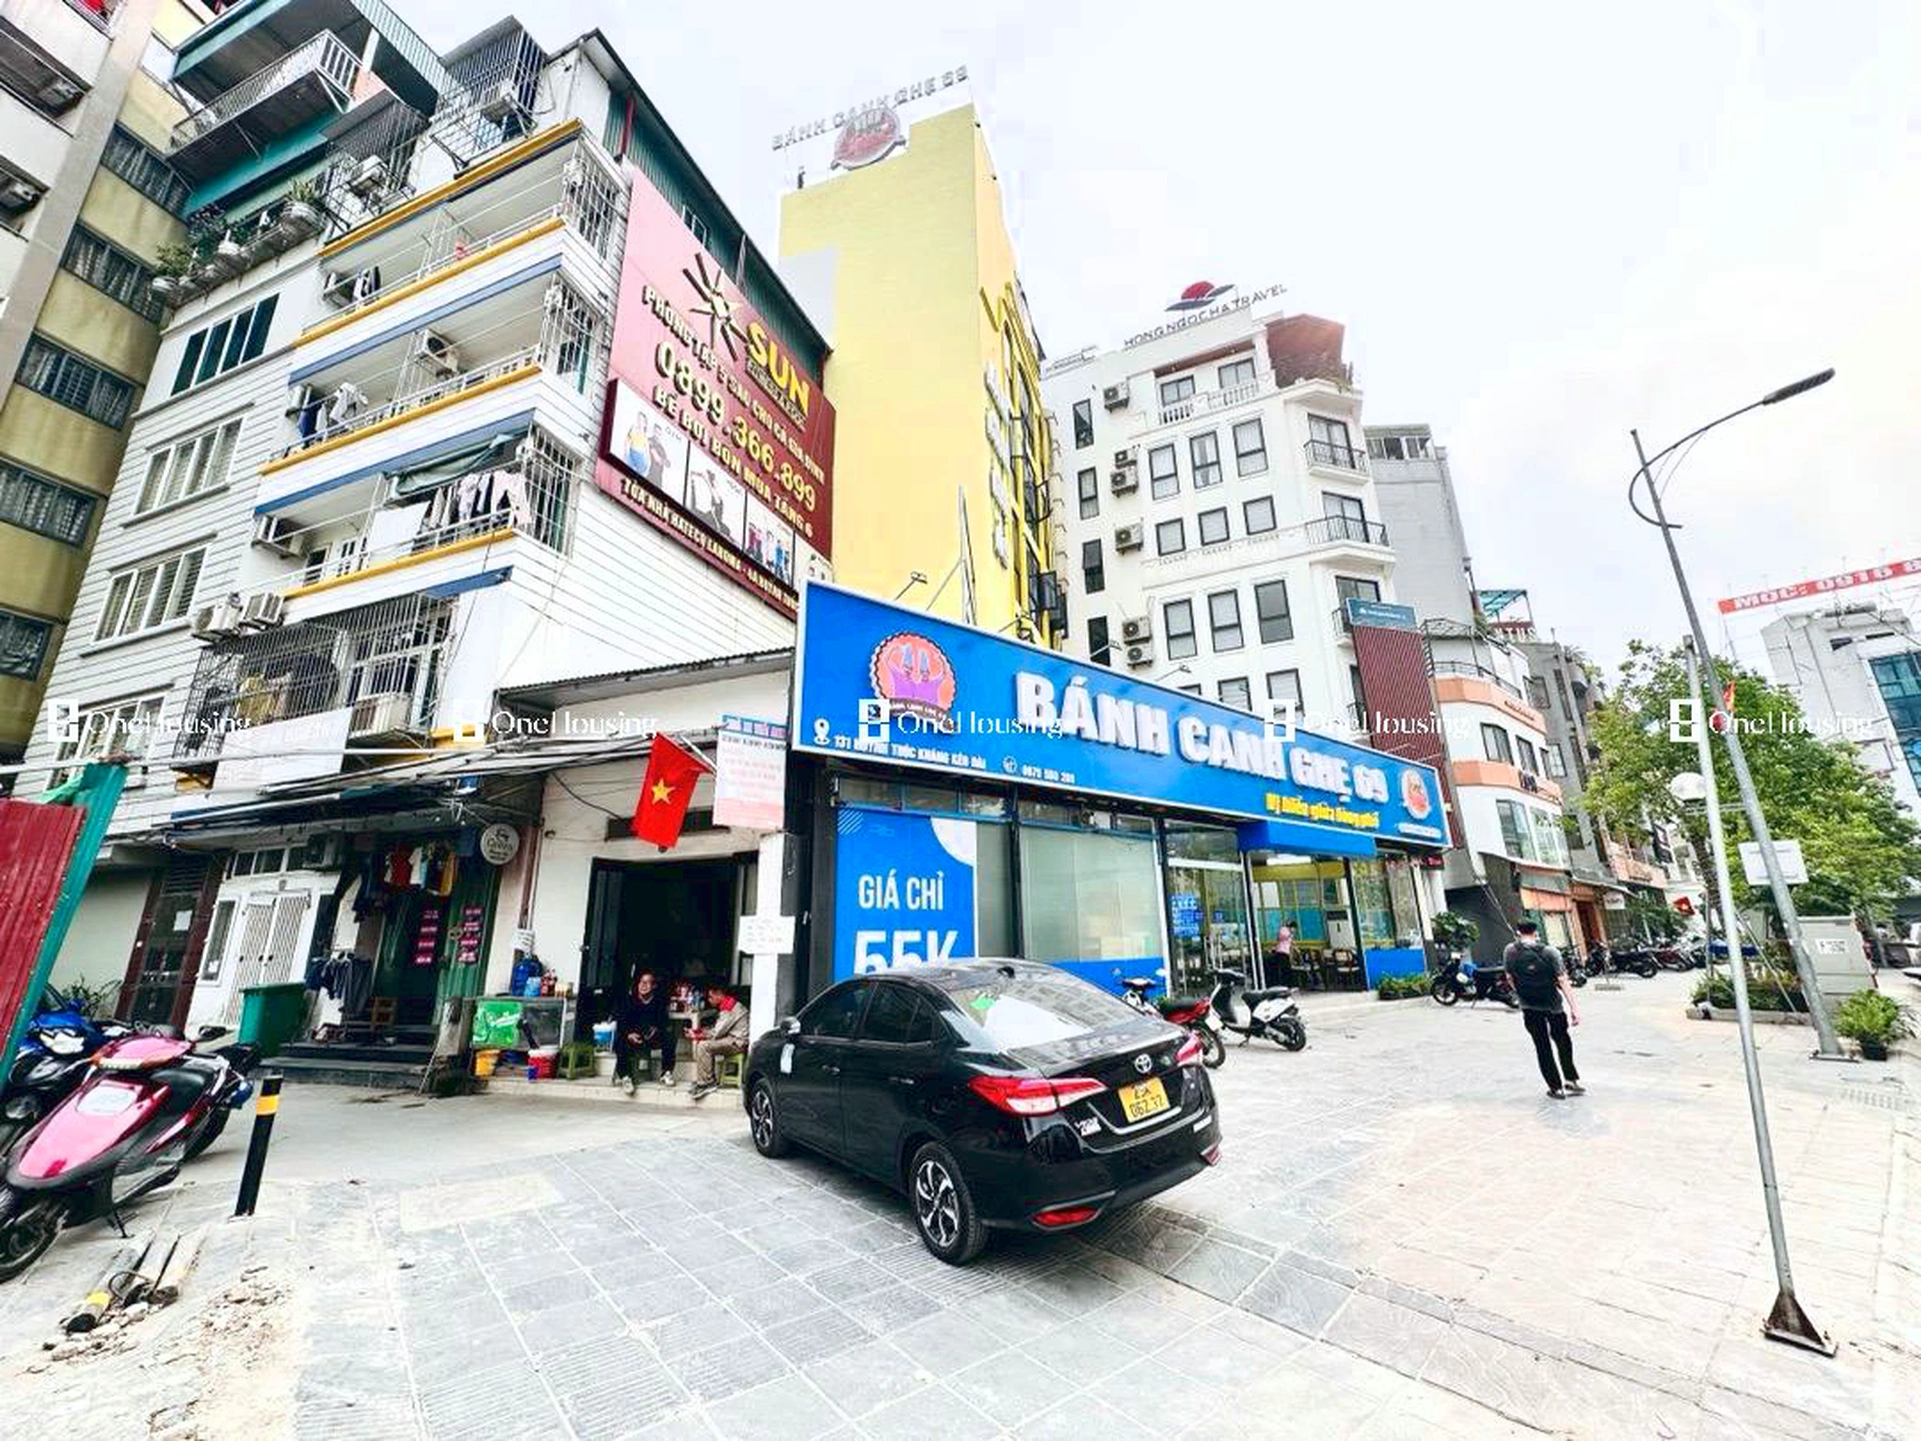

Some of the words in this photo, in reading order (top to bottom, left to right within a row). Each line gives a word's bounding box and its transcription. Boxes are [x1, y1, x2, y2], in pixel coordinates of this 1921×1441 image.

[1231, 284, 1288, 309] TRAVEL
[746, 322, 810, 417] SUN
[1016, 671, 1171, 756] BÁNH
[1178, 716, 1287, 780] CANH
[1288, 747, 1352, 803] GHẸ
[1352, 763, 1391, 804] 69
[858, 868, 900, 910] GIÁ
[906, 870, 944, 911] CHỈ
[854, 930, 958, 975] 55K
